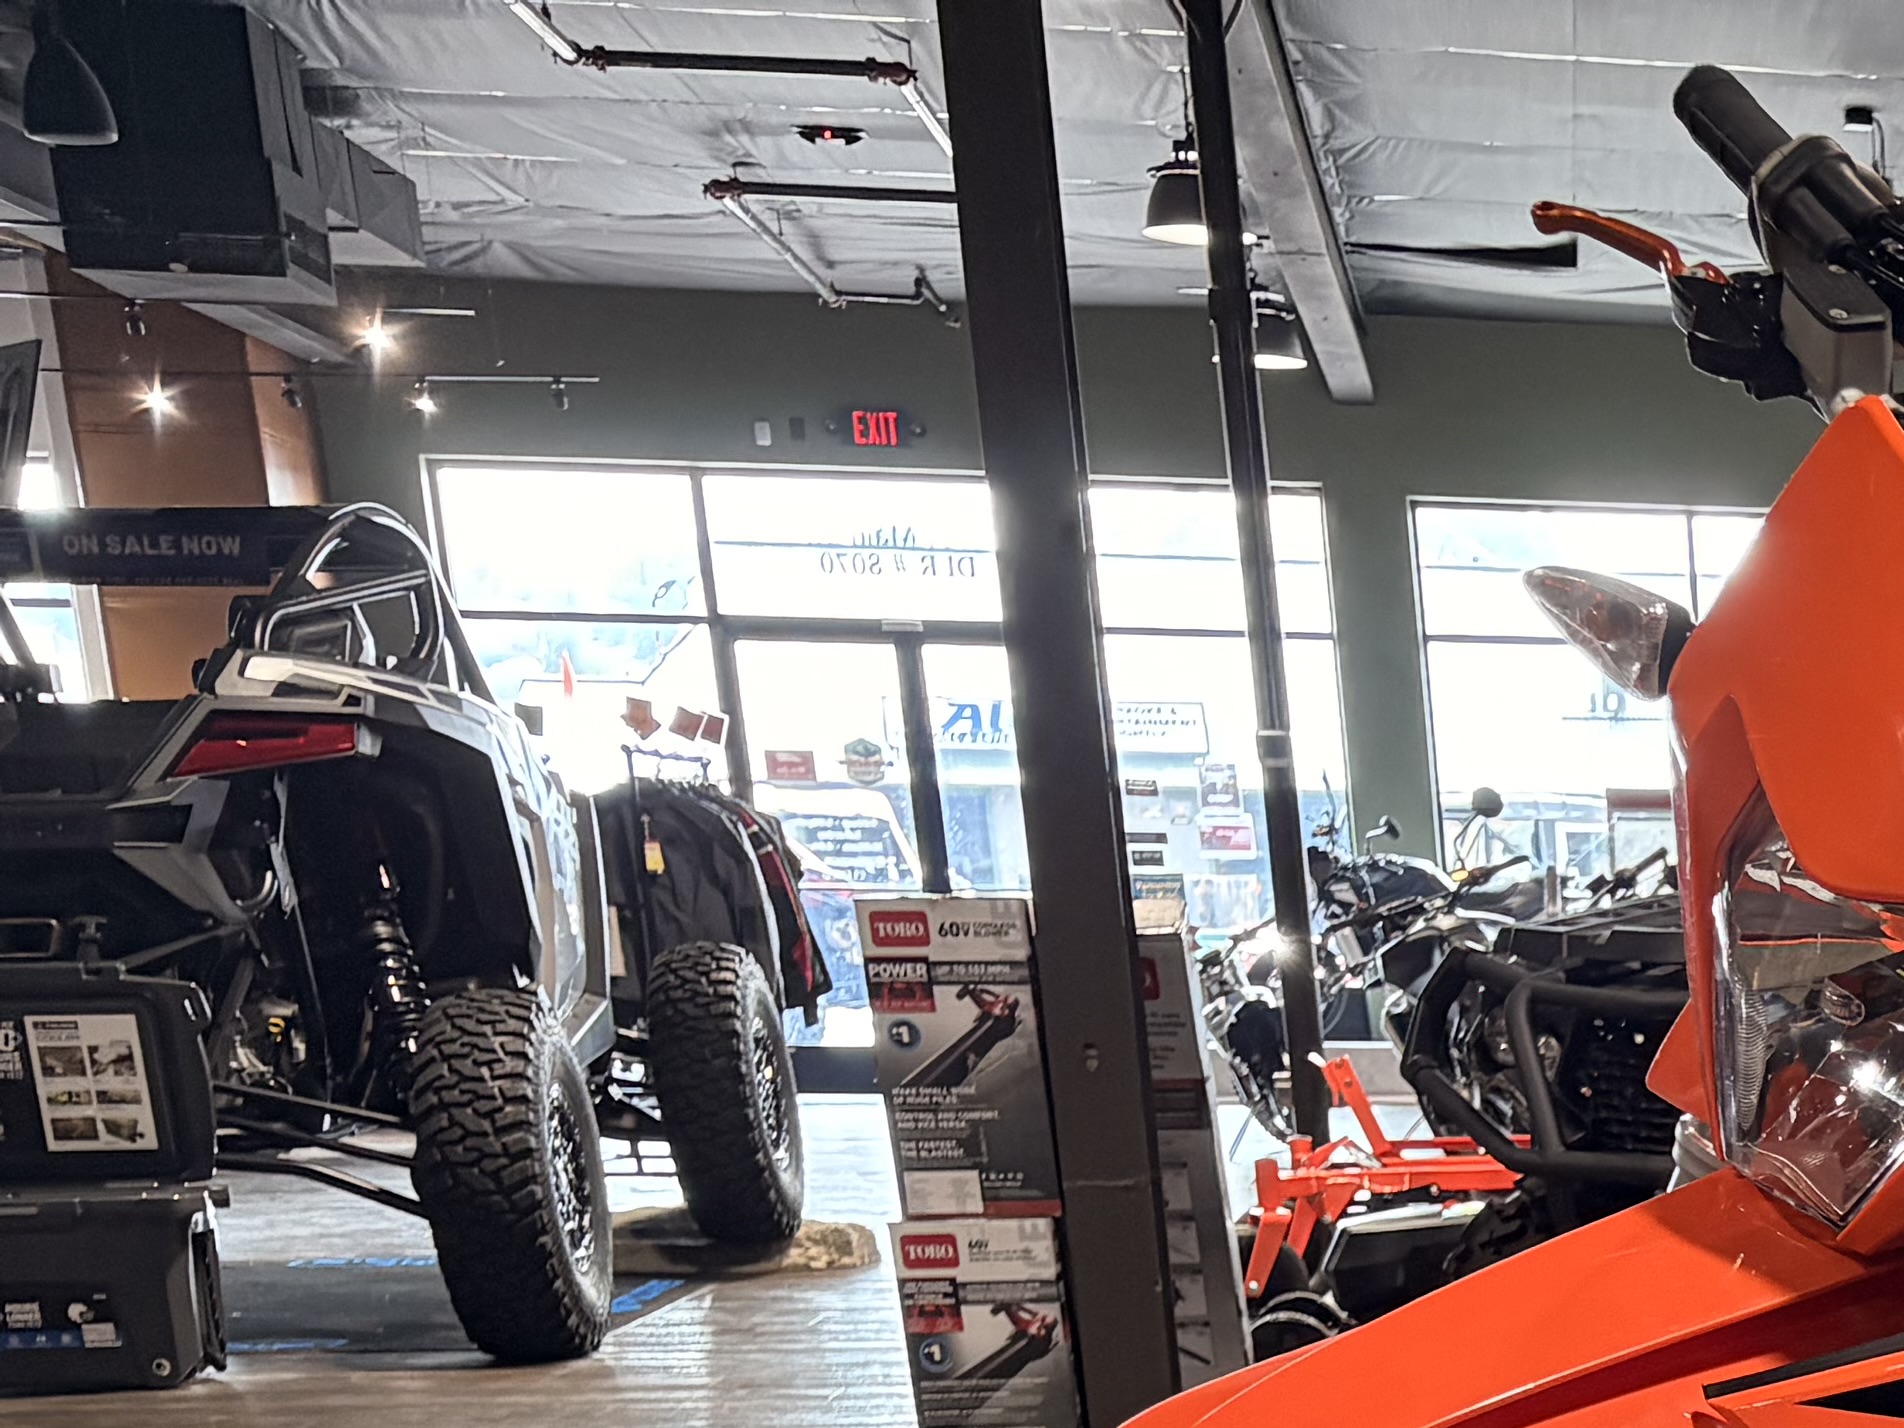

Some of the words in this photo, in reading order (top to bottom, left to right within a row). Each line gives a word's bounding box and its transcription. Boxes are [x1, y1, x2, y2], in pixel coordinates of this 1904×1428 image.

[852, 411, 897, 445] EXIT
[62, 535, 99, 556] ON
[105, 534, 176, 556] SALE
[181, 533, 241, 555] NOW
[874, 921, 926, 938] TORO
[868, 962, 929, 982] POWER
[905, 1243, 955, 1261] TORO
